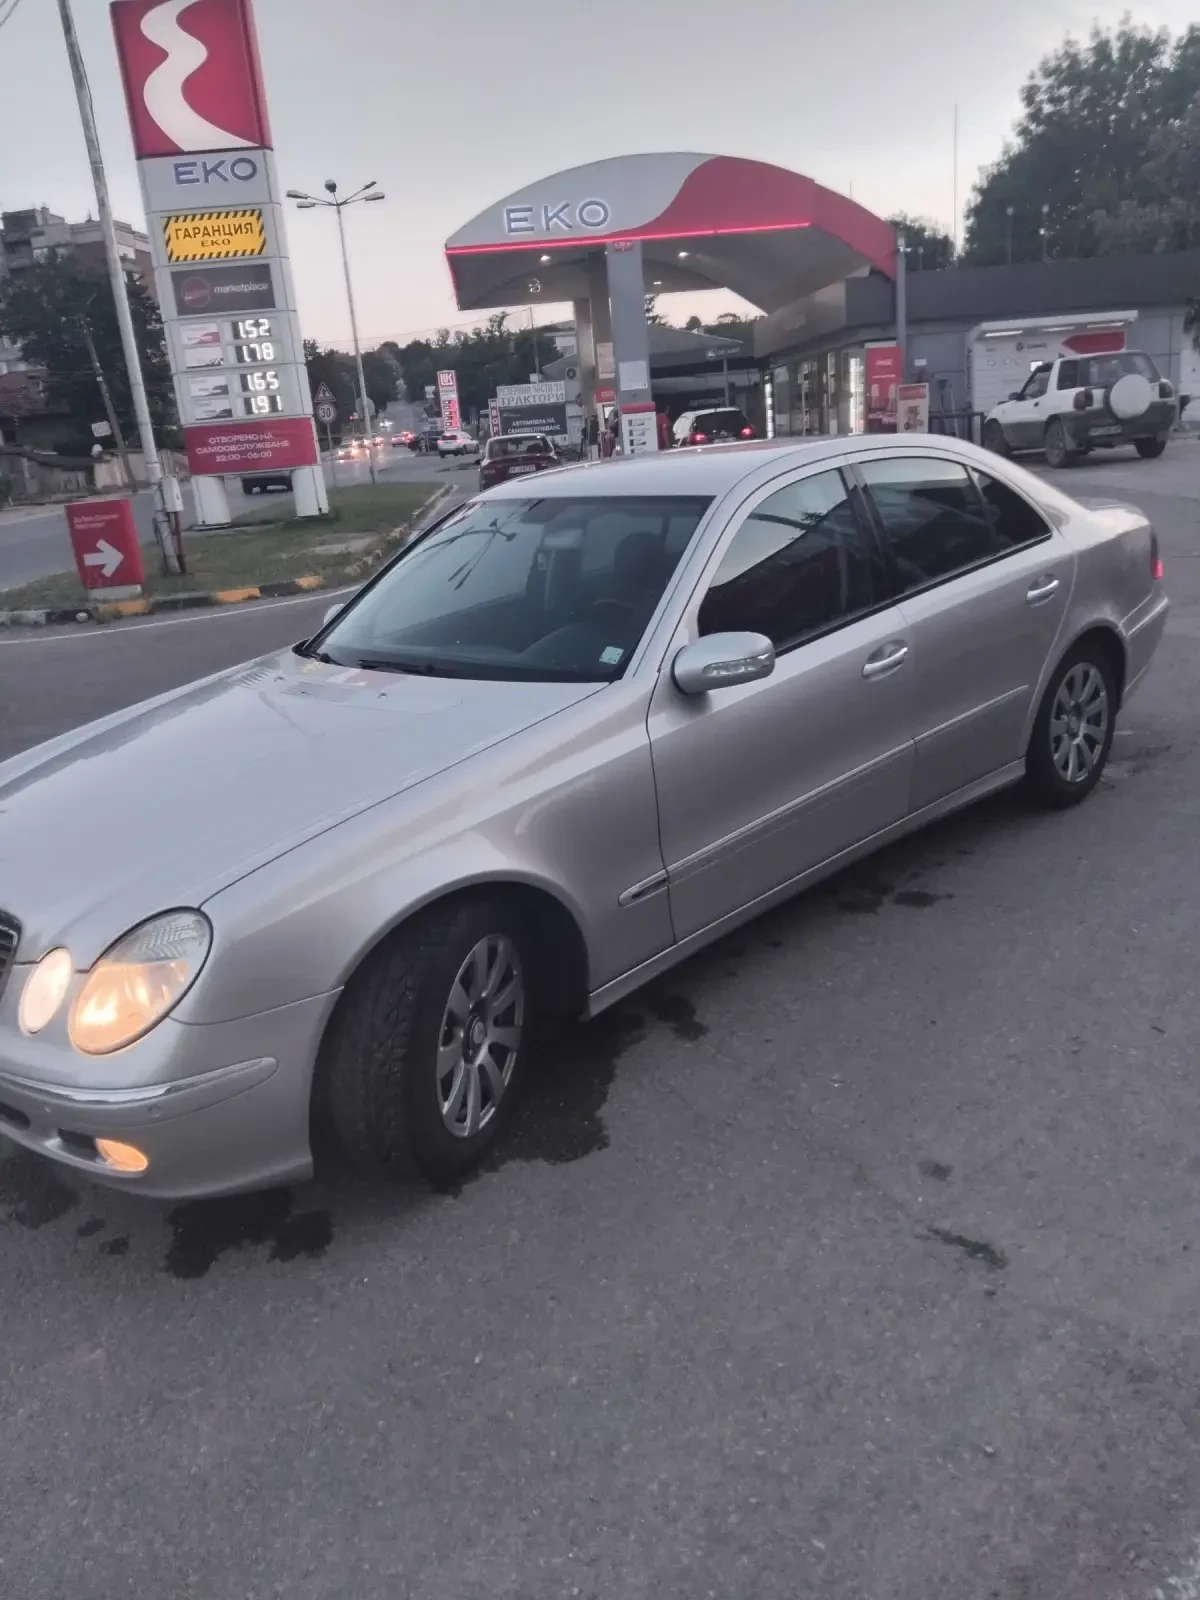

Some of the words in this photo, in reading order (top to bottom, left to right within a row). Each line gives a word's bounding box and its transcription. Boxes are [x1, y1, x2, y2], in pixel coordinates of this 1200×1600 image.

[173, 157, 258, 185] EKO
[504, 199, 609, 234] EKO
[174, 222, 254, 240] ГАРАНЦИЯ
[214, 282, 269, 294] marketplace
[499, 392, 564, 407] ТРАКТОРИ
[320, 407, 332, 418] 30
[208, 433, 259, 444] ОТВОРЕНО
[260, 432, 274, 440] НА
[196, 440, 290, 454] САМООБСЛУЖВАНЕ
[247, 450, 273, 459] 06:00
